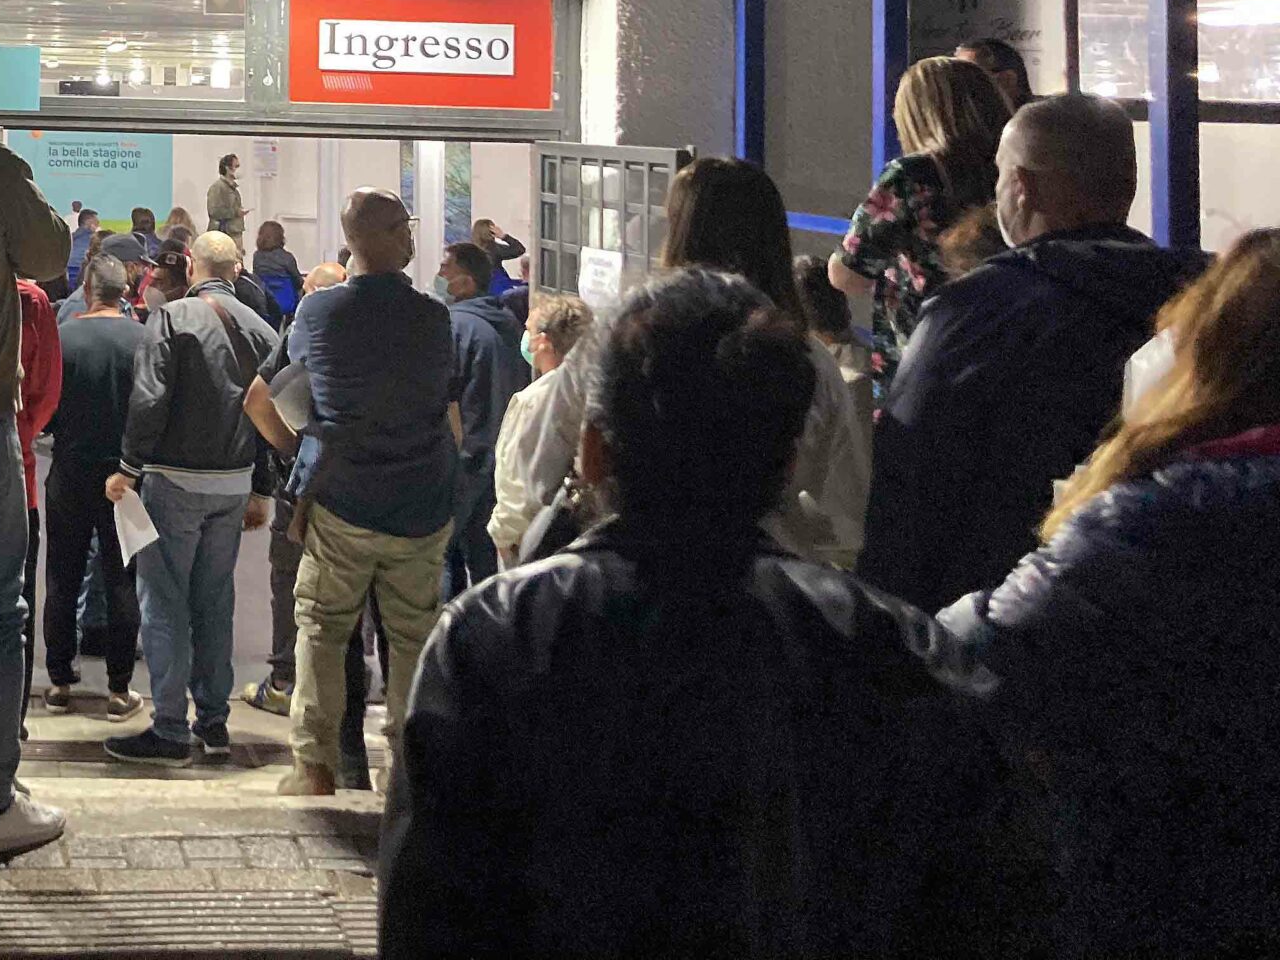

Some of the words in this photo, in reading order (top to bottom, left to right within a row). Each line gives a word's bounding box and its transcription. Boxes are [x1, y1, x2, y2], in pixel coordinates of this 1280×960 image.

[324, 22, 509, 69] Ingresso
[48, 146, 59, 157] la
[62, 146, 89, 157] bella
[92, 147, 141, 159] stagione
[48, 158, 100, 168] comincia
[103, 159, 117, 168] da
[120, 159, 139, 171] qui
